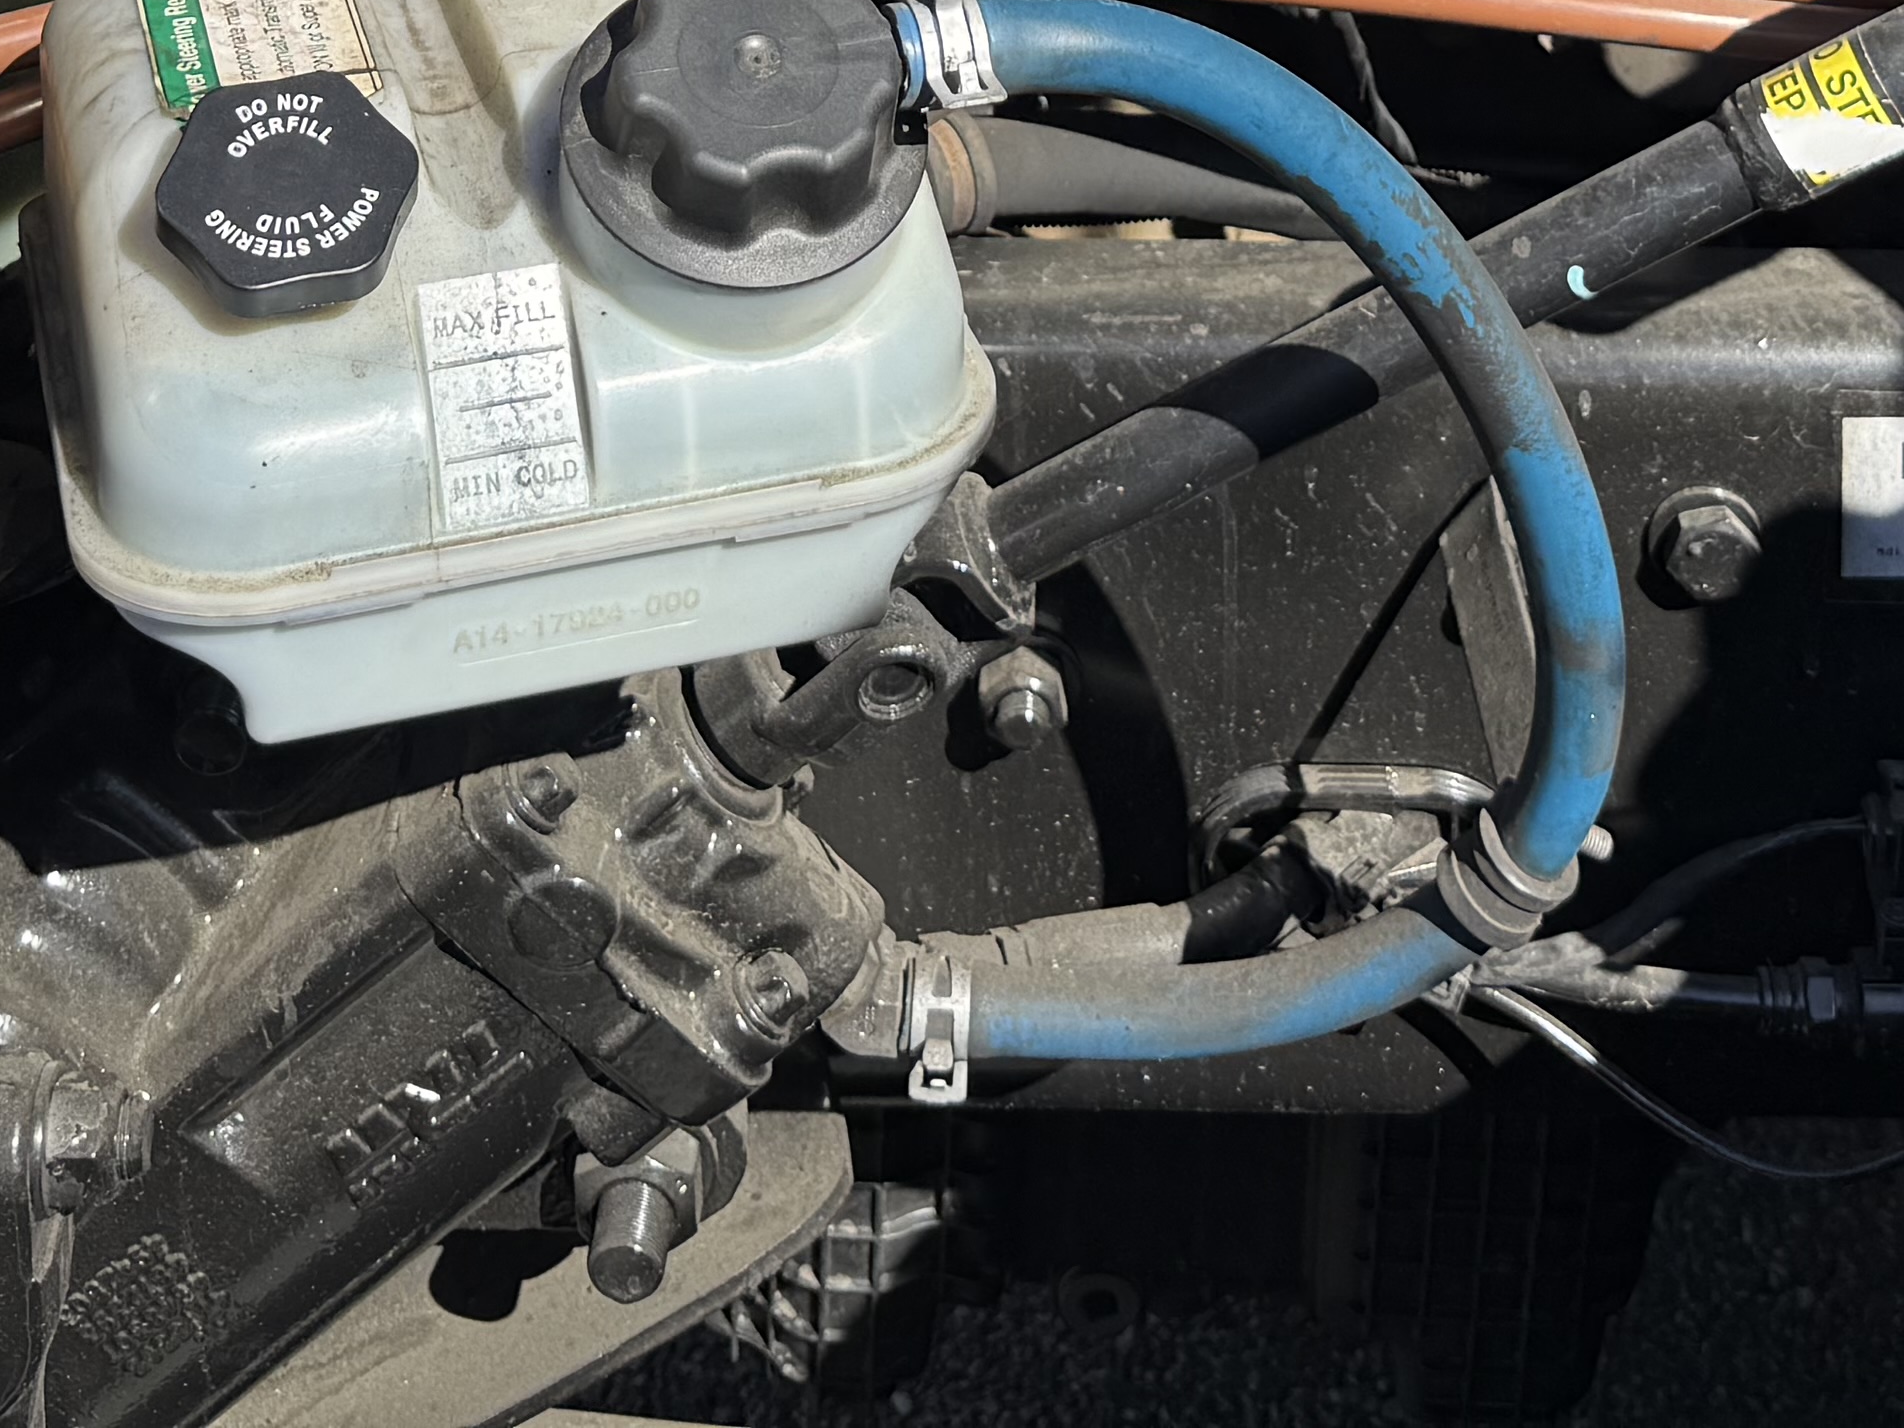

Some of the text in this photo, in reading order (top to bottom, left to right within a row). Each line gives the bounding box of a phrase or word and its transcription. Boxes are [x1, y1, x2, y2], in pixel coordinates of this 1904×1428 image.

[170, 14, 201, 73] Steering
[234, 93, 325, 124] DO NOT
[227, 115, 334, 159] OVERFILL
[204, 186, 380, 259] POWER STEERING
[255, 203, 336, 236] FLUID
[432, 300, 557, 339] MAX FILL
[451, 459, 579, 503] MIN COLD
[452, 586, 702, 656] A14-17924-000
